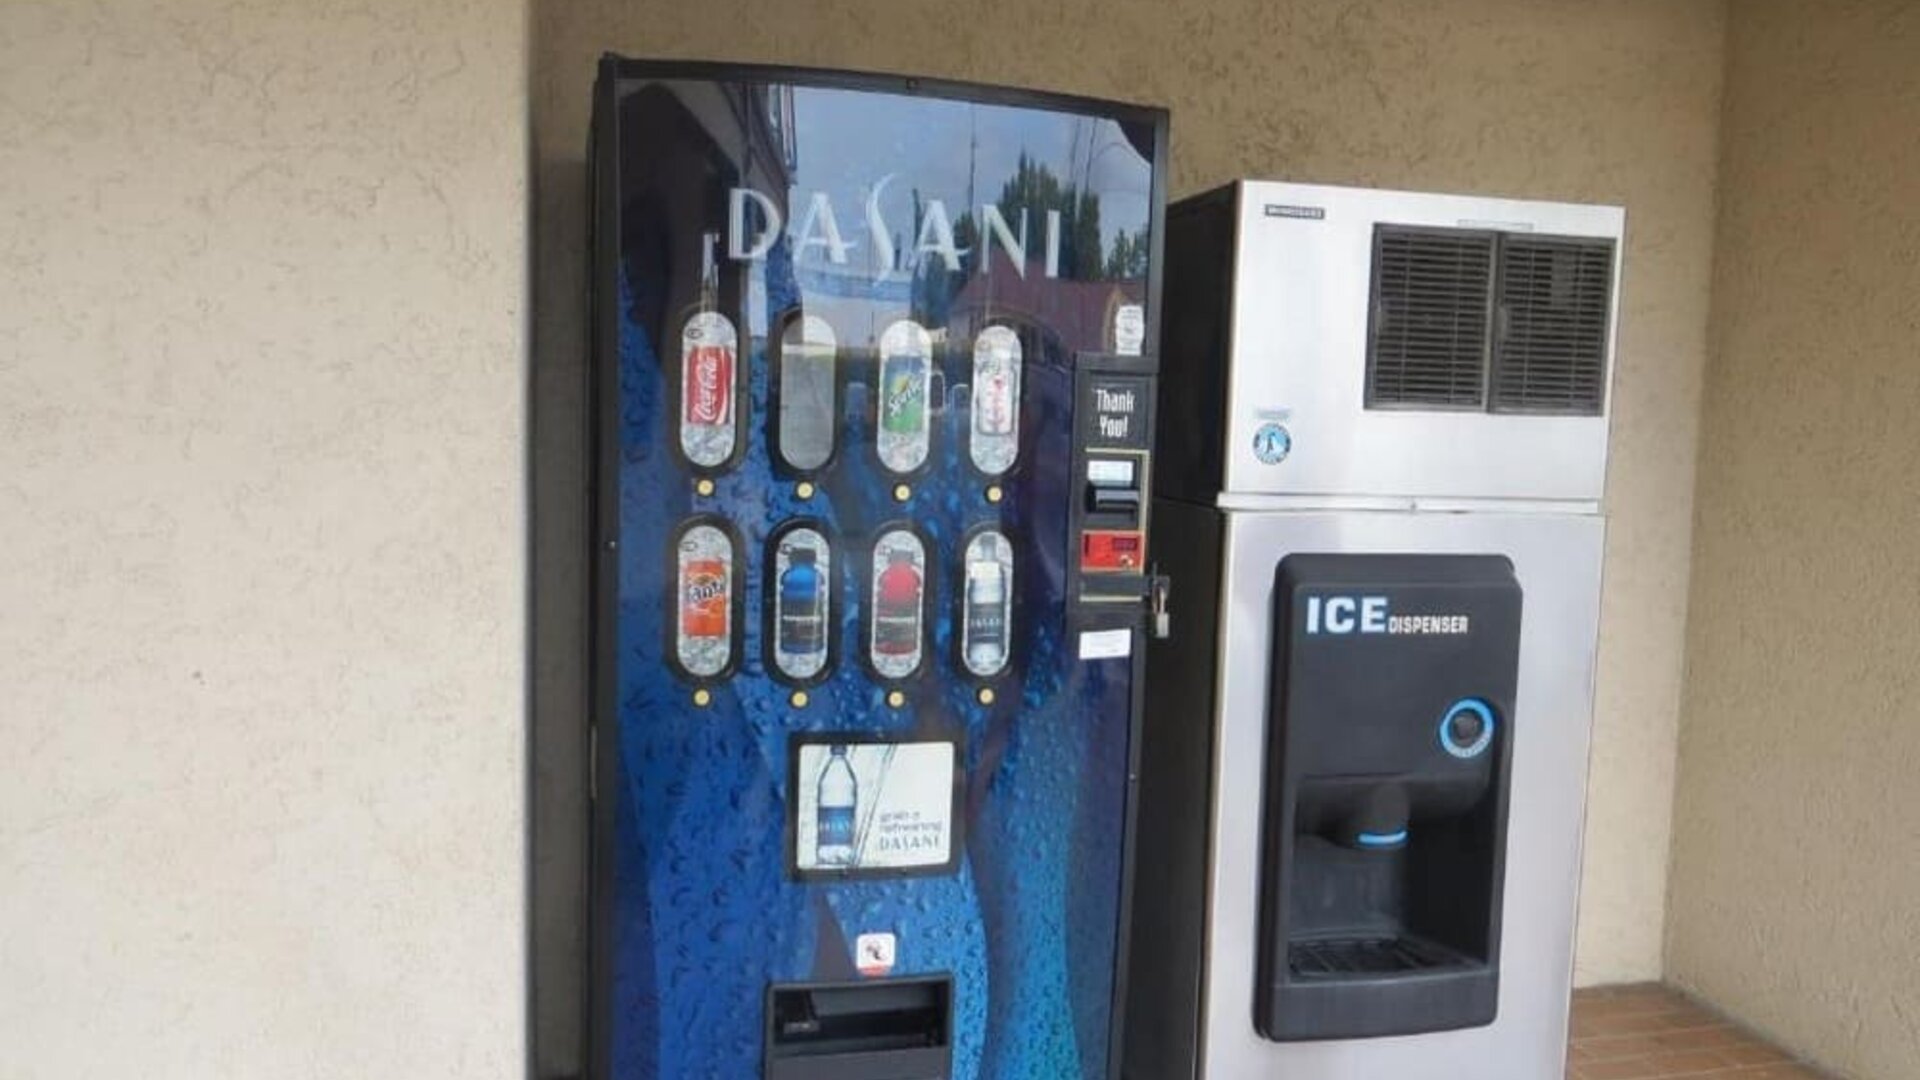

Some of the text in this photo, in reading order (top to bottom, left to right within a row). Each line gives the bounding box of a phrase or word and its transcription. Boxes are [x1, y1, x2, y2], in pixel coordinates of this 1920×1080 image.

[728, 173, 1061, 288] DASANI
[1095, 389, 1135, 413] Thank
[1100, 415, 1129, 437] You!
[1307, 597, 1469, 634] ICE DISPENSER
[880, 835, 940, 851] DASANI
